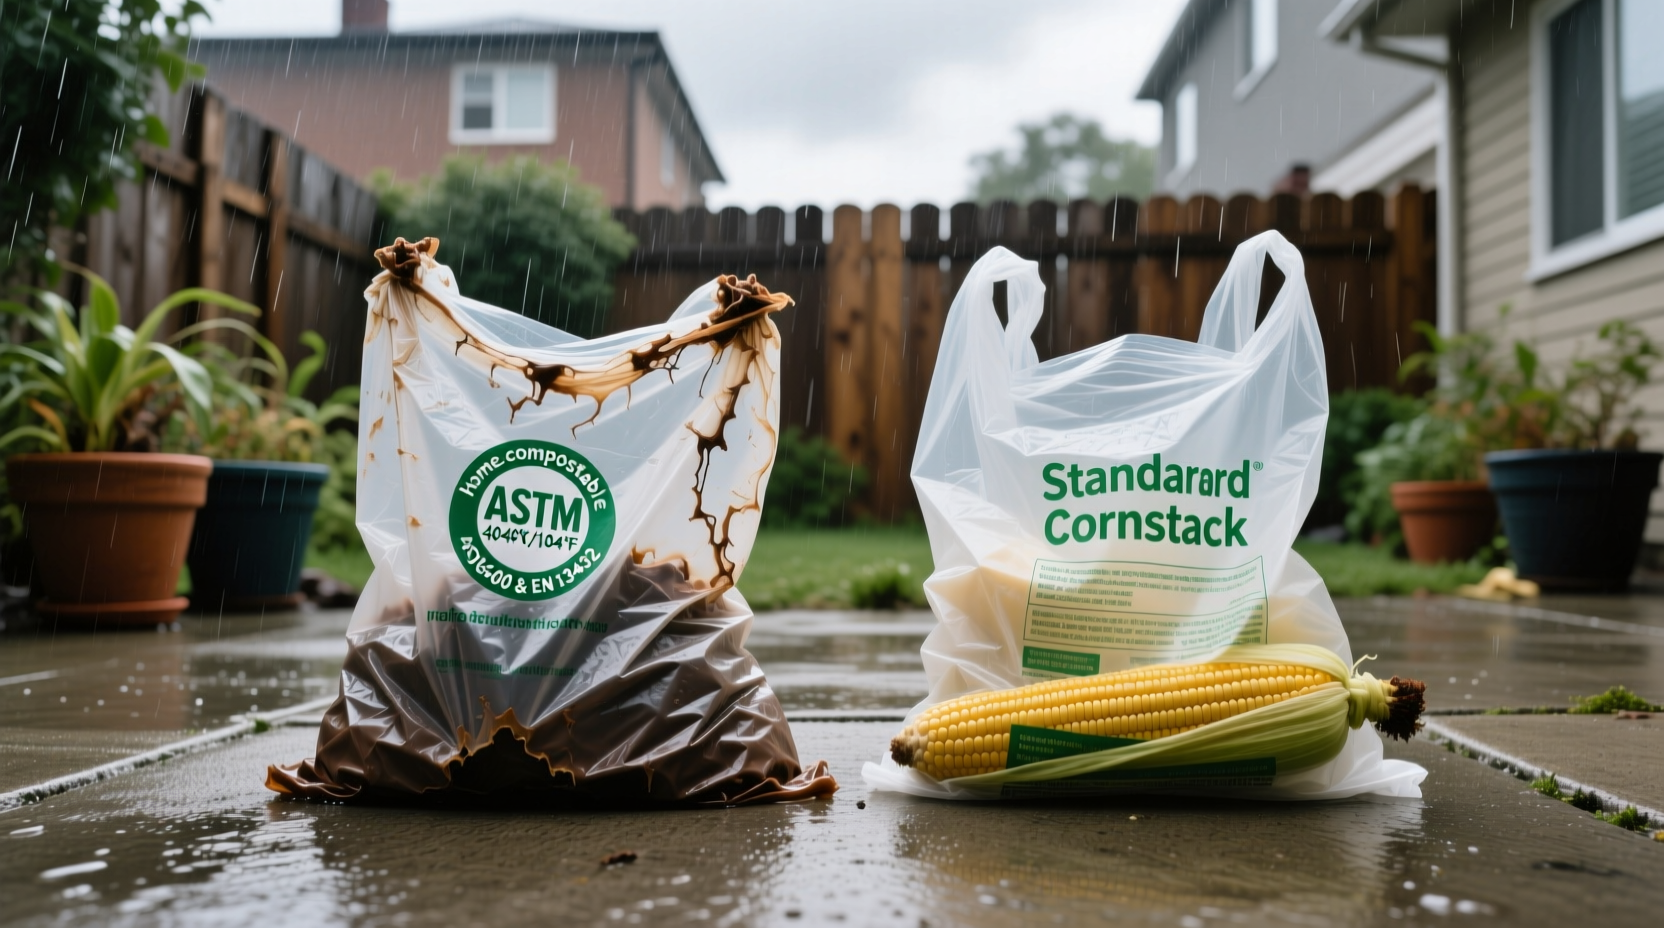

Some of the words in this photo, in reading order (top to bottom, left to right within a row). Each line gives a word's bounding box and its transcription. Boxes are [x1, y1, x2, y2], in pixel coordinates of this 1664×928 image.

[484, 485, 583, 533] ASTM
[1044, 505, 1249, 548] Cornstack
[531, 575, 554, 594] EN
